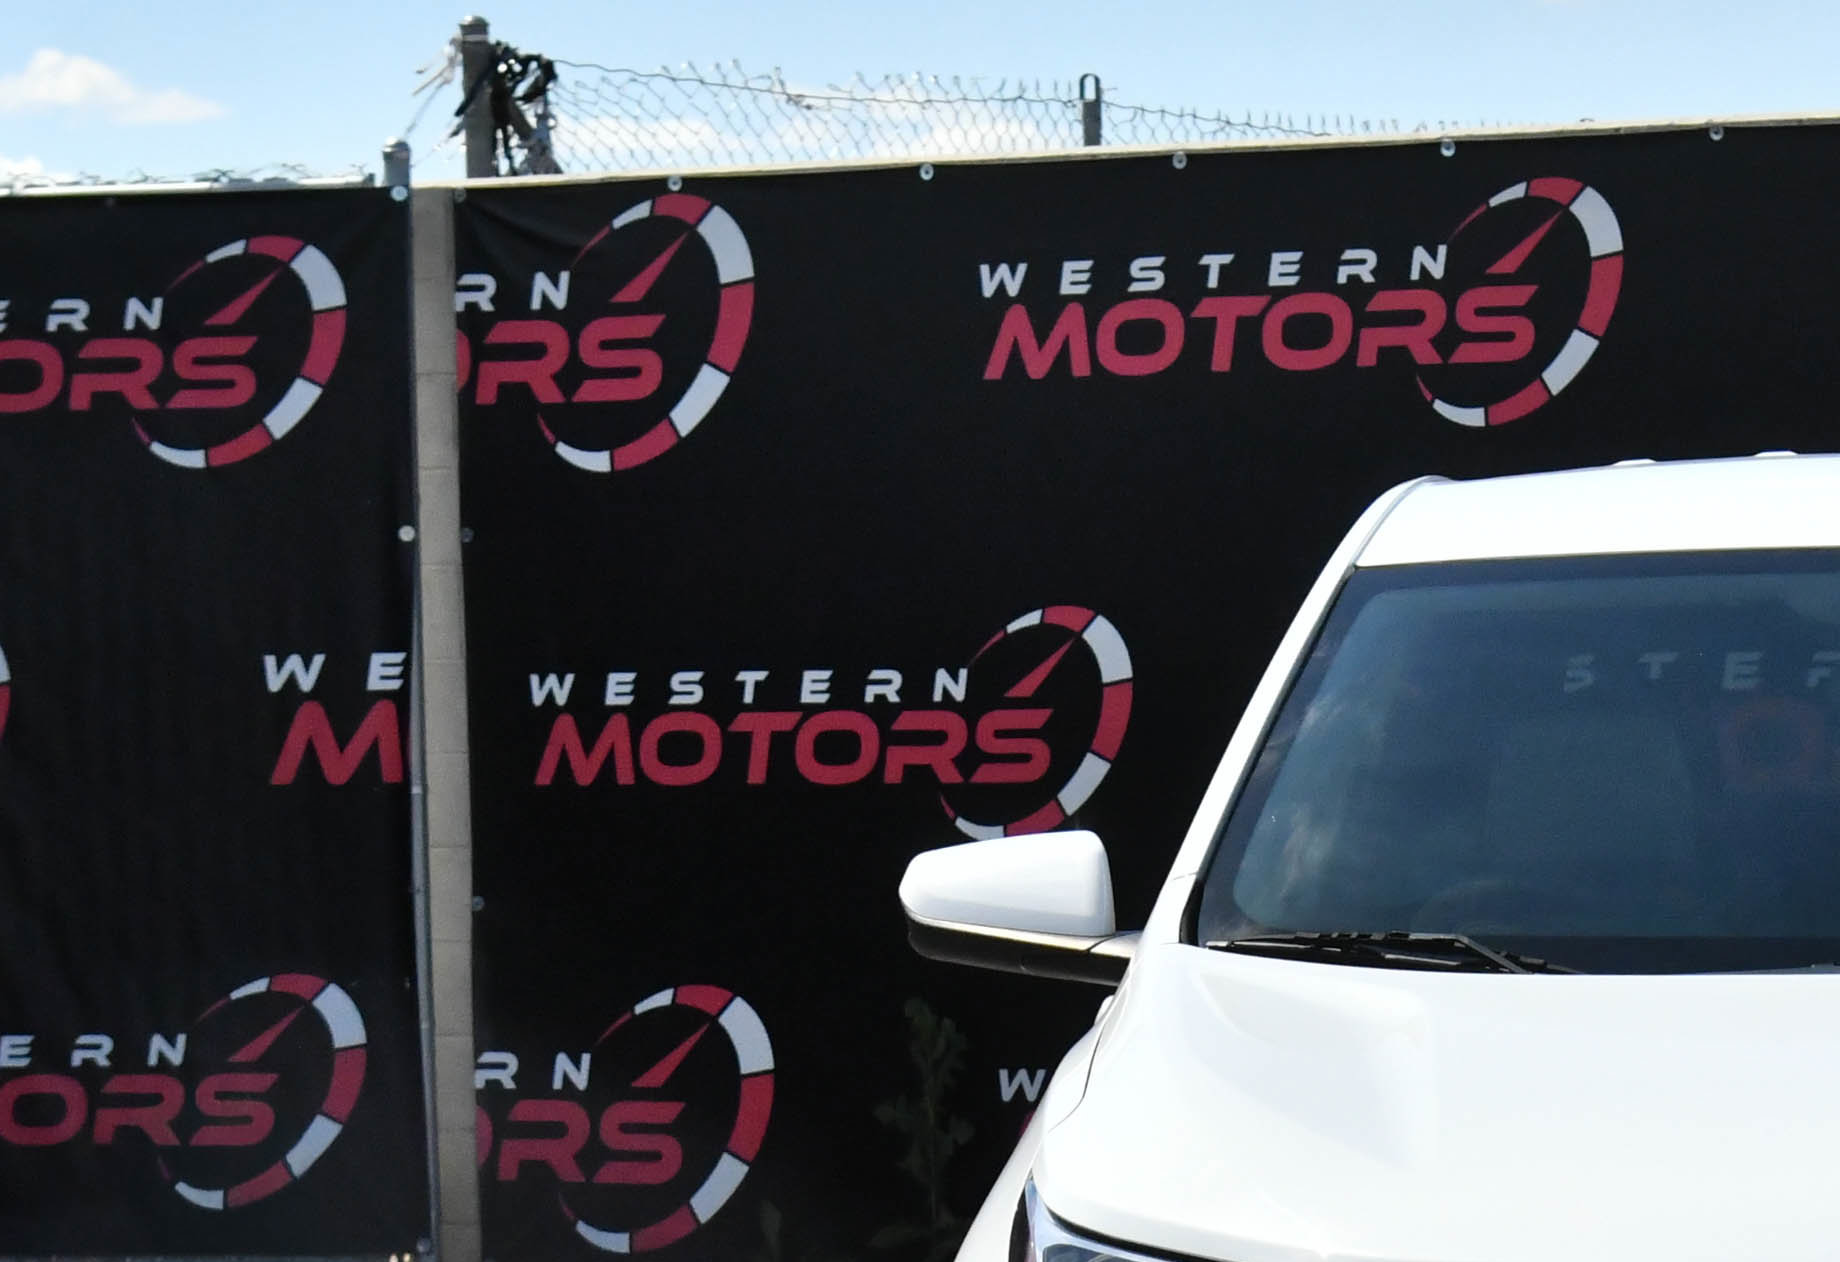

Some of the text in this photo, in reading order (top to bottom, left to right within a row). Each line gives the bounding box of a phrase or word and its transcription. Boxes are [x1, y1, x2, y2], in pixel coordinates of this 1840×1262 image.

[455, 270, 570, 312] RN
[979, 244, 1448, 298] WESTERN
[0, 297, 163, 333] RN
[983, 284, 1537, 380] MOTORS
[0, 336, 258, 413] ORS
[456, 314, 666, 405] RS
[263, 652, 407, 693] WE
[529, 667, 968, 707] WESTERN
[534, 708, 1053, 786] MOTORS
[475, 1051, 591, 1091] RN
[0, 1074, 279, 1146] ORS
[475, 1099, 686, 1185] RS
